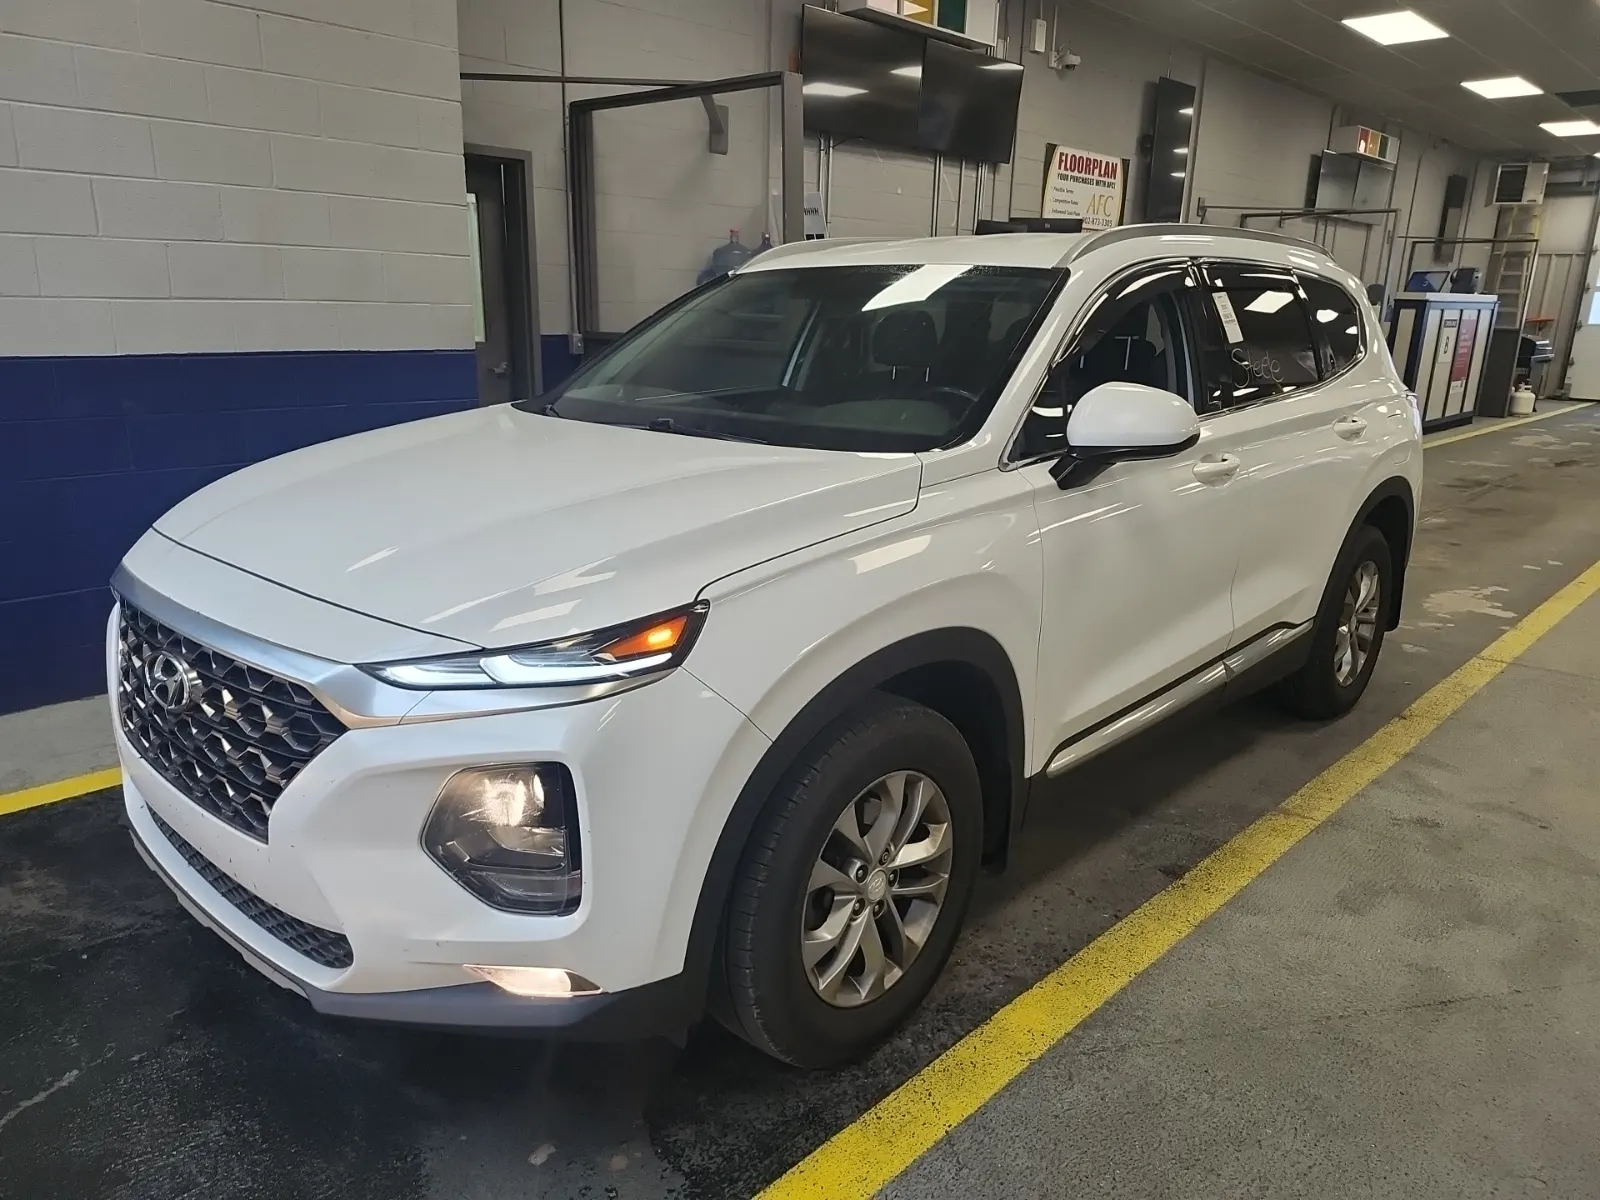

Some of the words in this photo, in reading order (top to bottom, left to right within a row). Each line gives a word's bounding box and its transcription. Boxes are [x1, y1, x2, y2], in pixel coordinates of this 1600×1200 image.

[1058, 152, 1118, 180] FLOORPLAN
[1057, 172, 1069, 182] YOUR
[1069, 174, 1095, 186] PURCHASES
[1095, 178, 1106, 188] WITH
[1086, 193, 1114, 217] AFC
